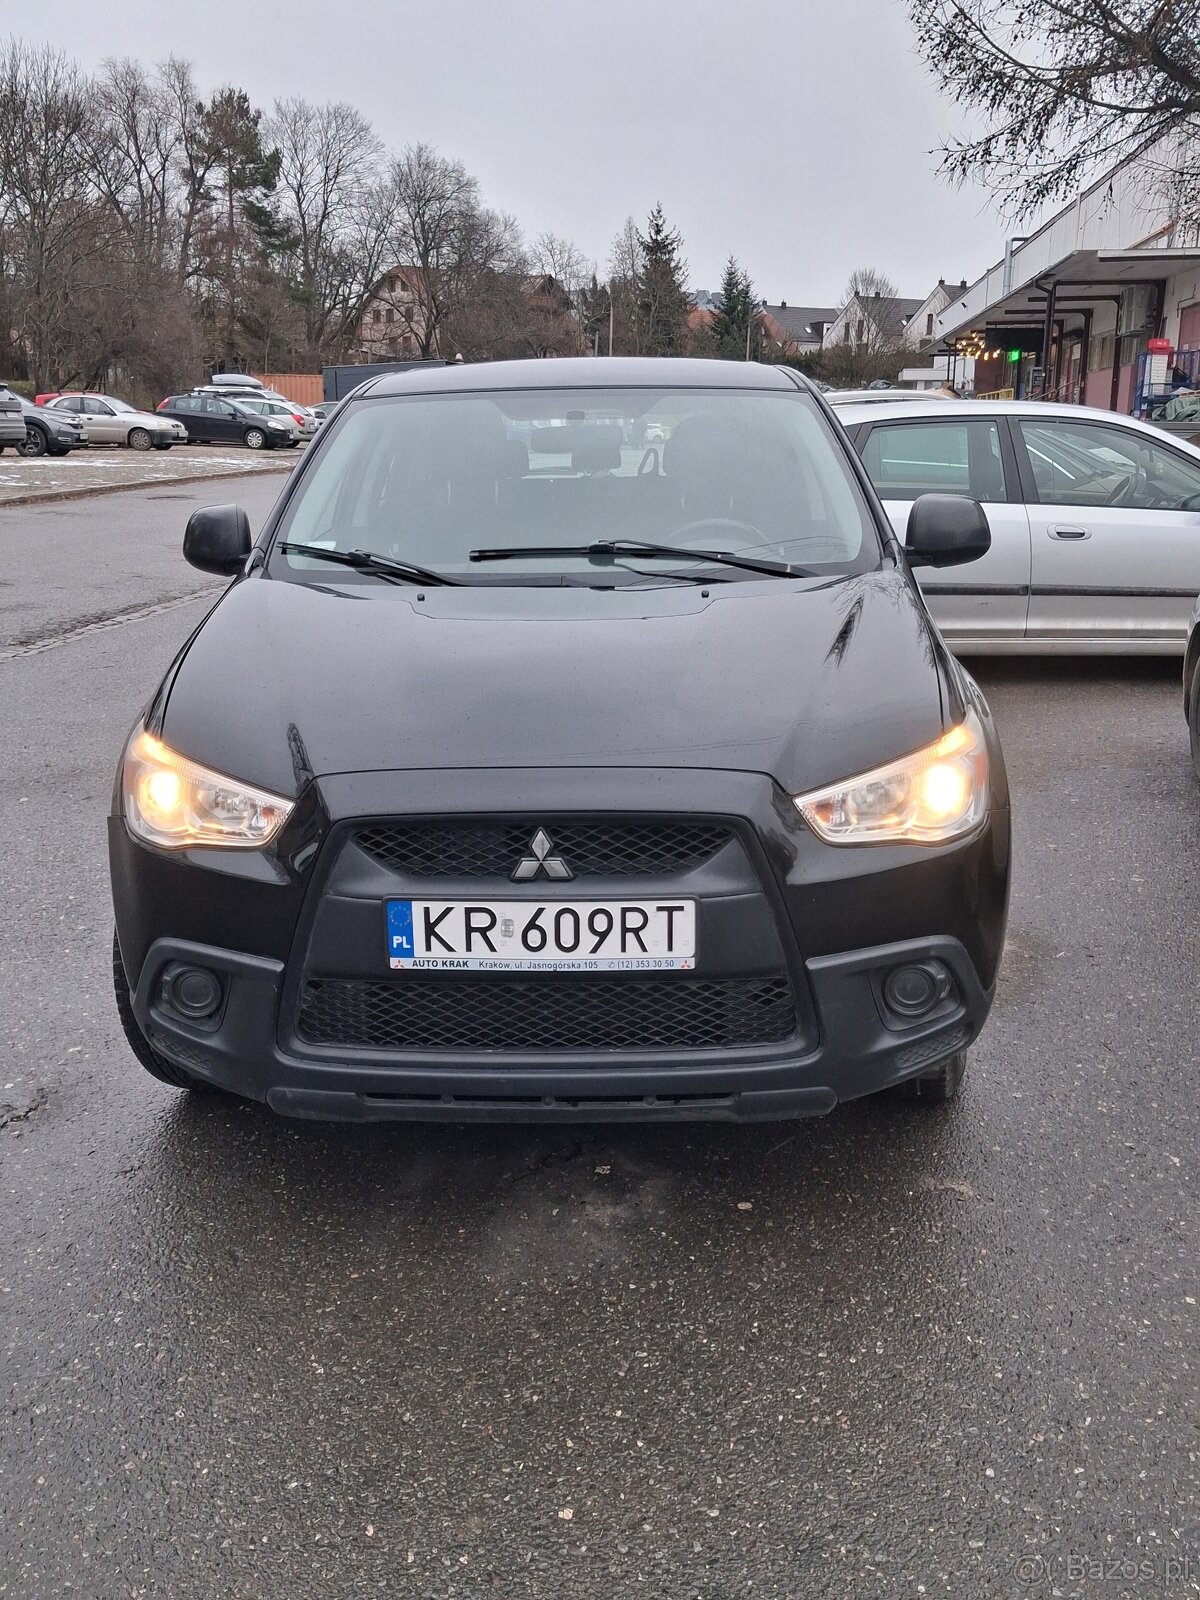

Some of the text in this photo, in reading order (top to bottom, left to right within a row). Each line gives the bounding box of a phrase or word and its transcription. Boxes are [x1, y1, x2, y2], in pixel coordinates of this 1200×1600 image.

[423, 905, 685, 954] KR 609RT
[392, 935, 411, 949] PL
[412, 960, 439, 968] AUTO
[441, 960, 470, 968] KRAK
[514, 960, 525, 969] ul.
[584, 961, 598, 969] 105
[617, 960, 633, 969] (12)
[635, 960, 651, 968] 353
[652, 960, 662, 968] 30
[664, 960, 675, 968] 50
